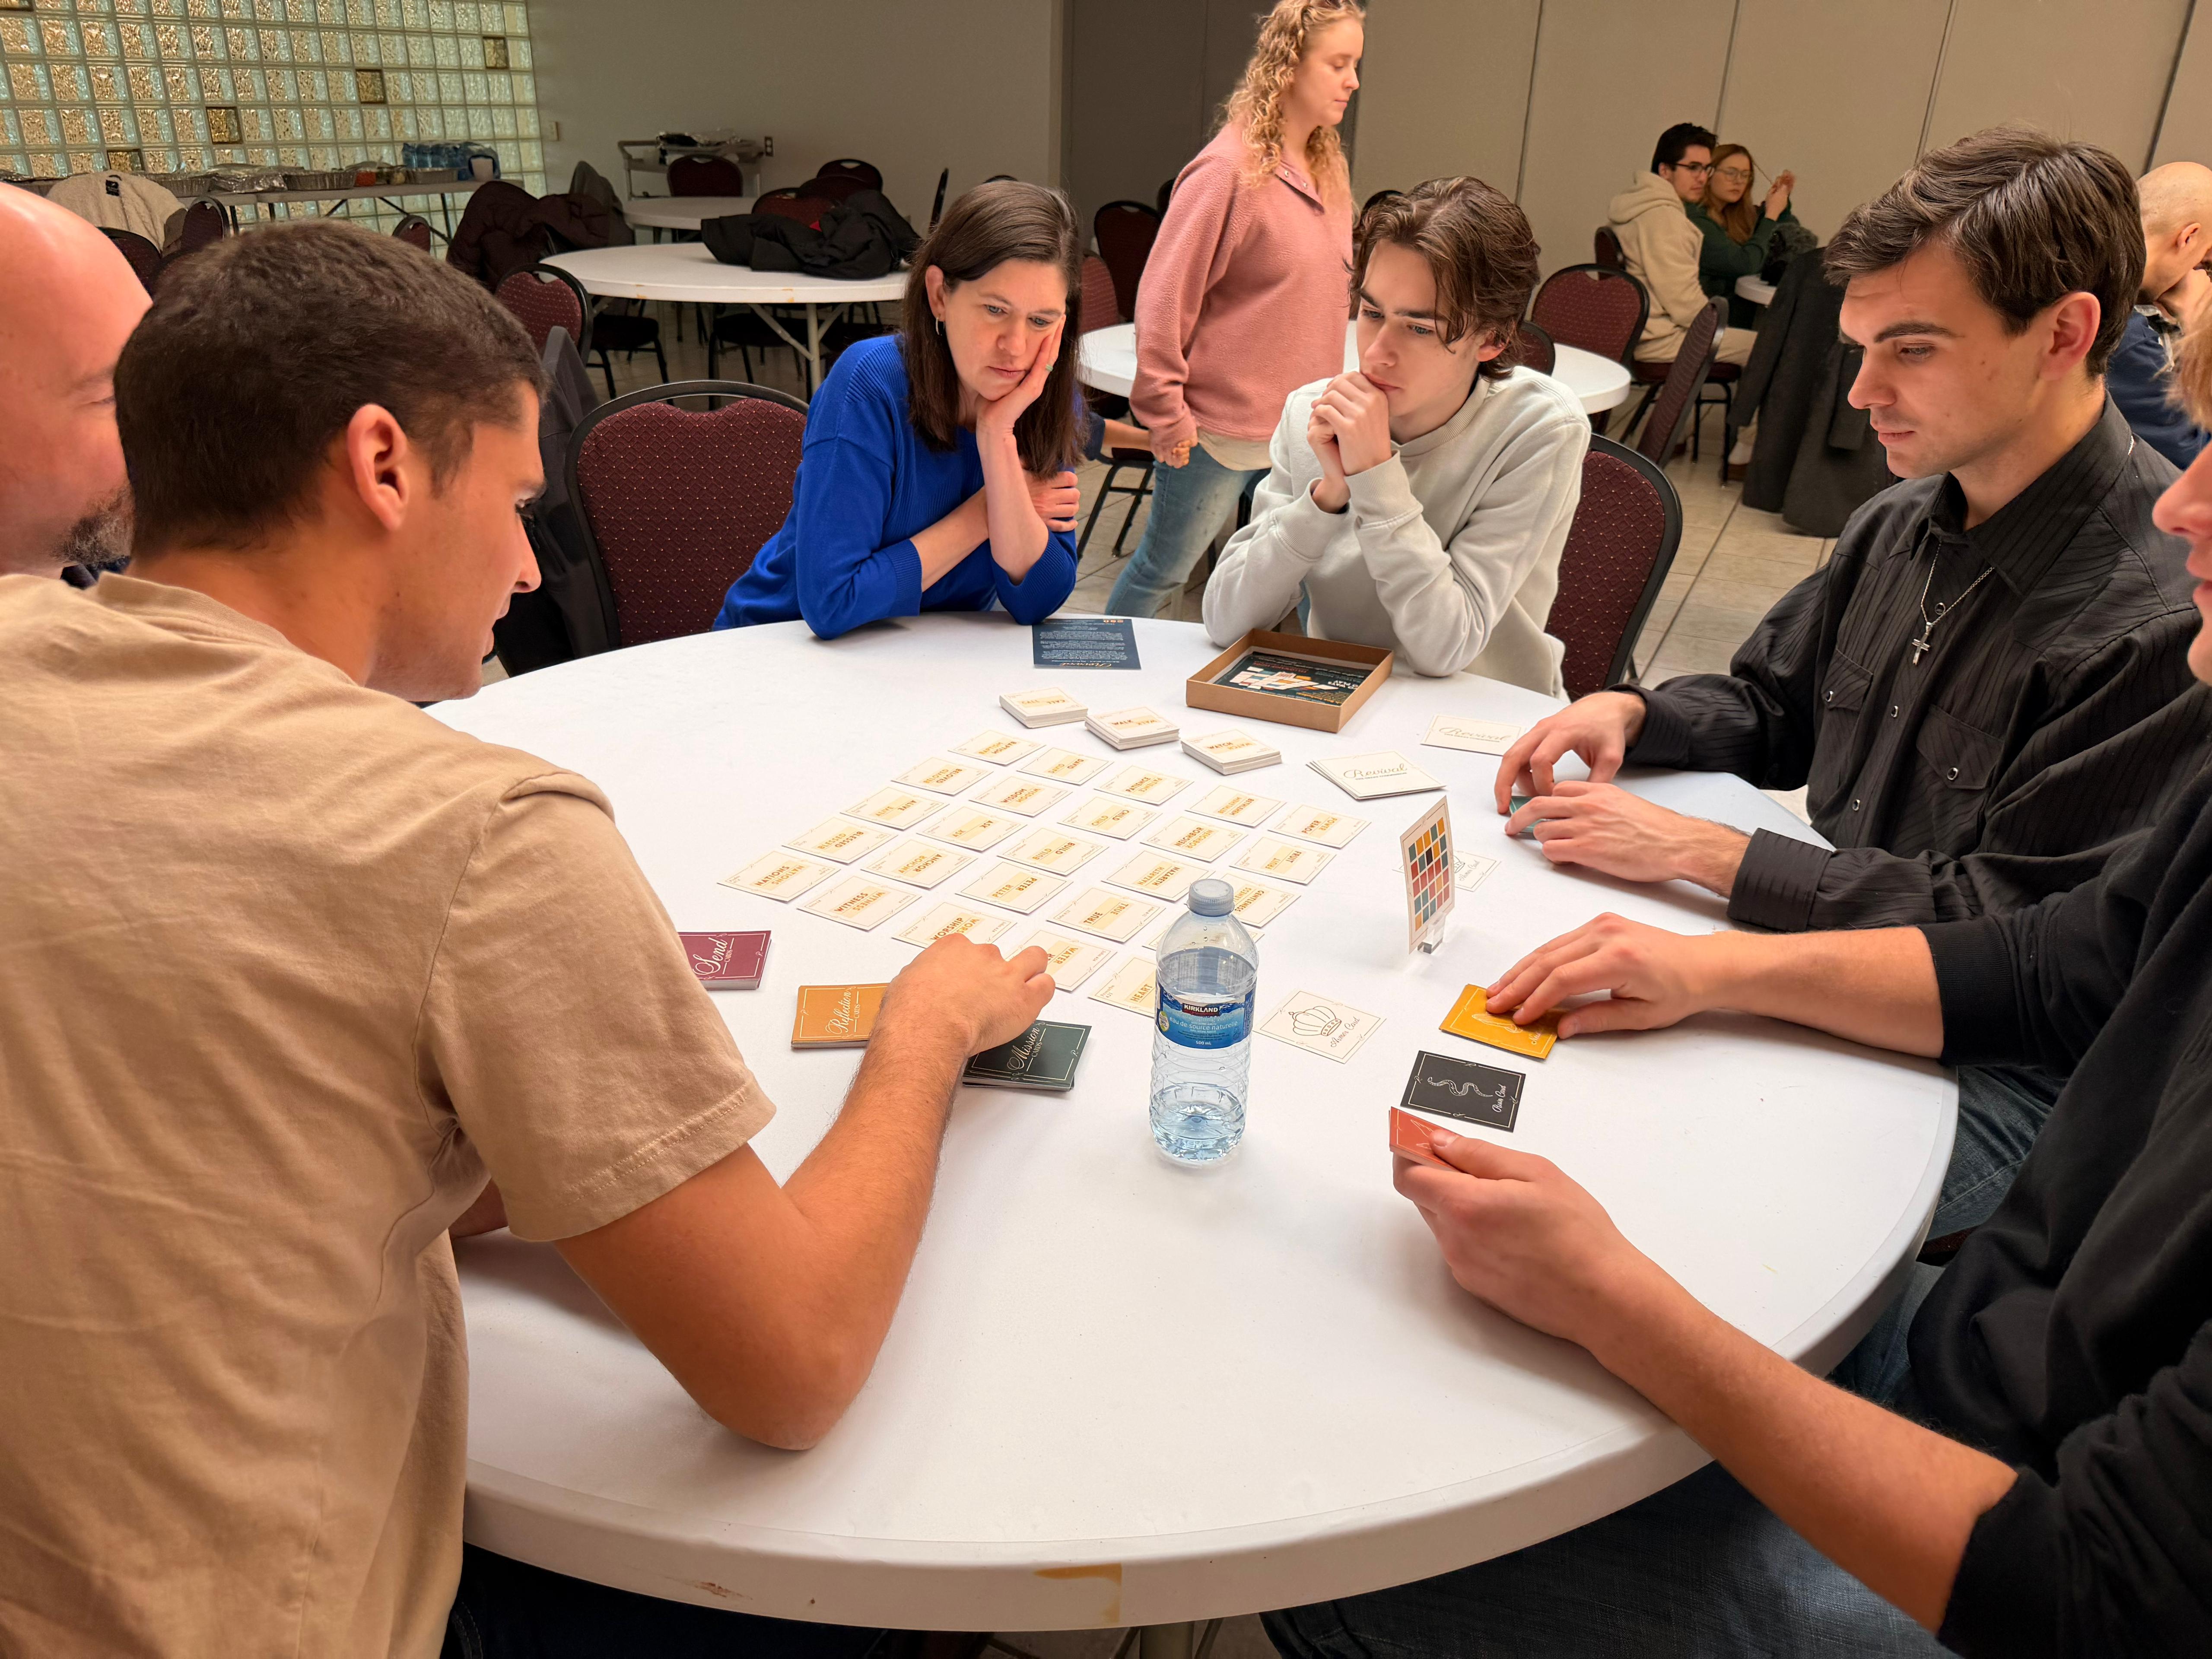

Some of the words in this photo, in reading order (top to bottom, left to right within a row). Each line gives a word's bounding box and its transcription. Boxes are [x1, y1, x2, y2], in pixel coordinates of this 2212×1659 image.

[978, 742, 1003, 754] BAPTISM
[992, 741, 1017, 754] BAPTISM
[1048, 763, 1065, 774] DAVID
[1067, 759, 1084, 769] DAVID
[1344, 763, 1408, 778] Revival
[923, 769, 949, 784] BELOVED
[936, 768, 963, 784] BELOVED
[1125, 776, 1151, 792] PATIENCE
[1138, 777, 1163, 792] PATIENCE
[999, 788, 1027, 803] WISDOM
[1016, 788, 1040, 803] WISDOM
[875, 806, 894, 817] ALIVE
[897, 800, 917, 811] ALIVE
[1217, 797, 1242, 814] BETHLEHEM
[1229, 798, 1255, 816] BETHLEHEM
[1091, 815, 1108, 826] CHILD
[1112, 809, 1129, 821] CHILD
[979, 820, 994, 829] ASK
[1301, 820, 1322, 834] POWER
[1319, 817, 1338, 831] POWER
[834, 831, 864, 848] BLESSED
[952, 829, 966, 838] ASK
[1173, 826, 1205, 847] NEIGHBOR
[1185, 830, 1214, 849] NEIGHBOR
[817, 833, 846, 850] BLESSED
[1055, 842, 1075, 855] BUILD
[1032, 848, 1052, 860] BUILD
[1285, 850, 1302, 863] FRUIT
[898, 855, 928, 874] ANCHOR
[912, 854, 943, 872] ANCHOR
[1265, 858, 1281, 870] FRUIT
[754, 865, 790, 886] NATIONS
[771, 865, 805, 885] NATIONS
[1137, 866, 1165, 886] NAZARETH
[1152, 866, 1181, 886] NAZARETH
[992, 884, 1014, 897] PETER
[1015, 877, 1038, 891] PETER
[833, 892, 869, 912] WITNESS
[852, 892, 885, 911] WITNESS
[1233, 887, 1252, 902] LENESS
[1234, 890, 1265, 912] GENTLENESS
[1110, 903, 1129, 915] TRUE
[1083, 911, 1103, 925] TRUE
[930, 917, 964, 941] WORSHIP
[955, 918, 980, 934] WORS
[692, 937, 728, 975] Send
[1053, 947, 1078, 964] WATER
[1131, 983, 1153, 1002] HEART
[825, 989, 854, 1034] Reflection
[1184, 1004, 1218, 1013] KIRKLAND
[1170, 1016, 1180, 1025] eau
[1189, 1022, 1210, 1030] source
[1212, 1020, 1238, 1030] naturelle
[1344, 1016, 1360, 1031] Card
[1007, 1027, 1040, 1070] Mission
[1032, 1042, 1042, 1058] CARDS
[1495, 1083, 1507, 1098] Card
